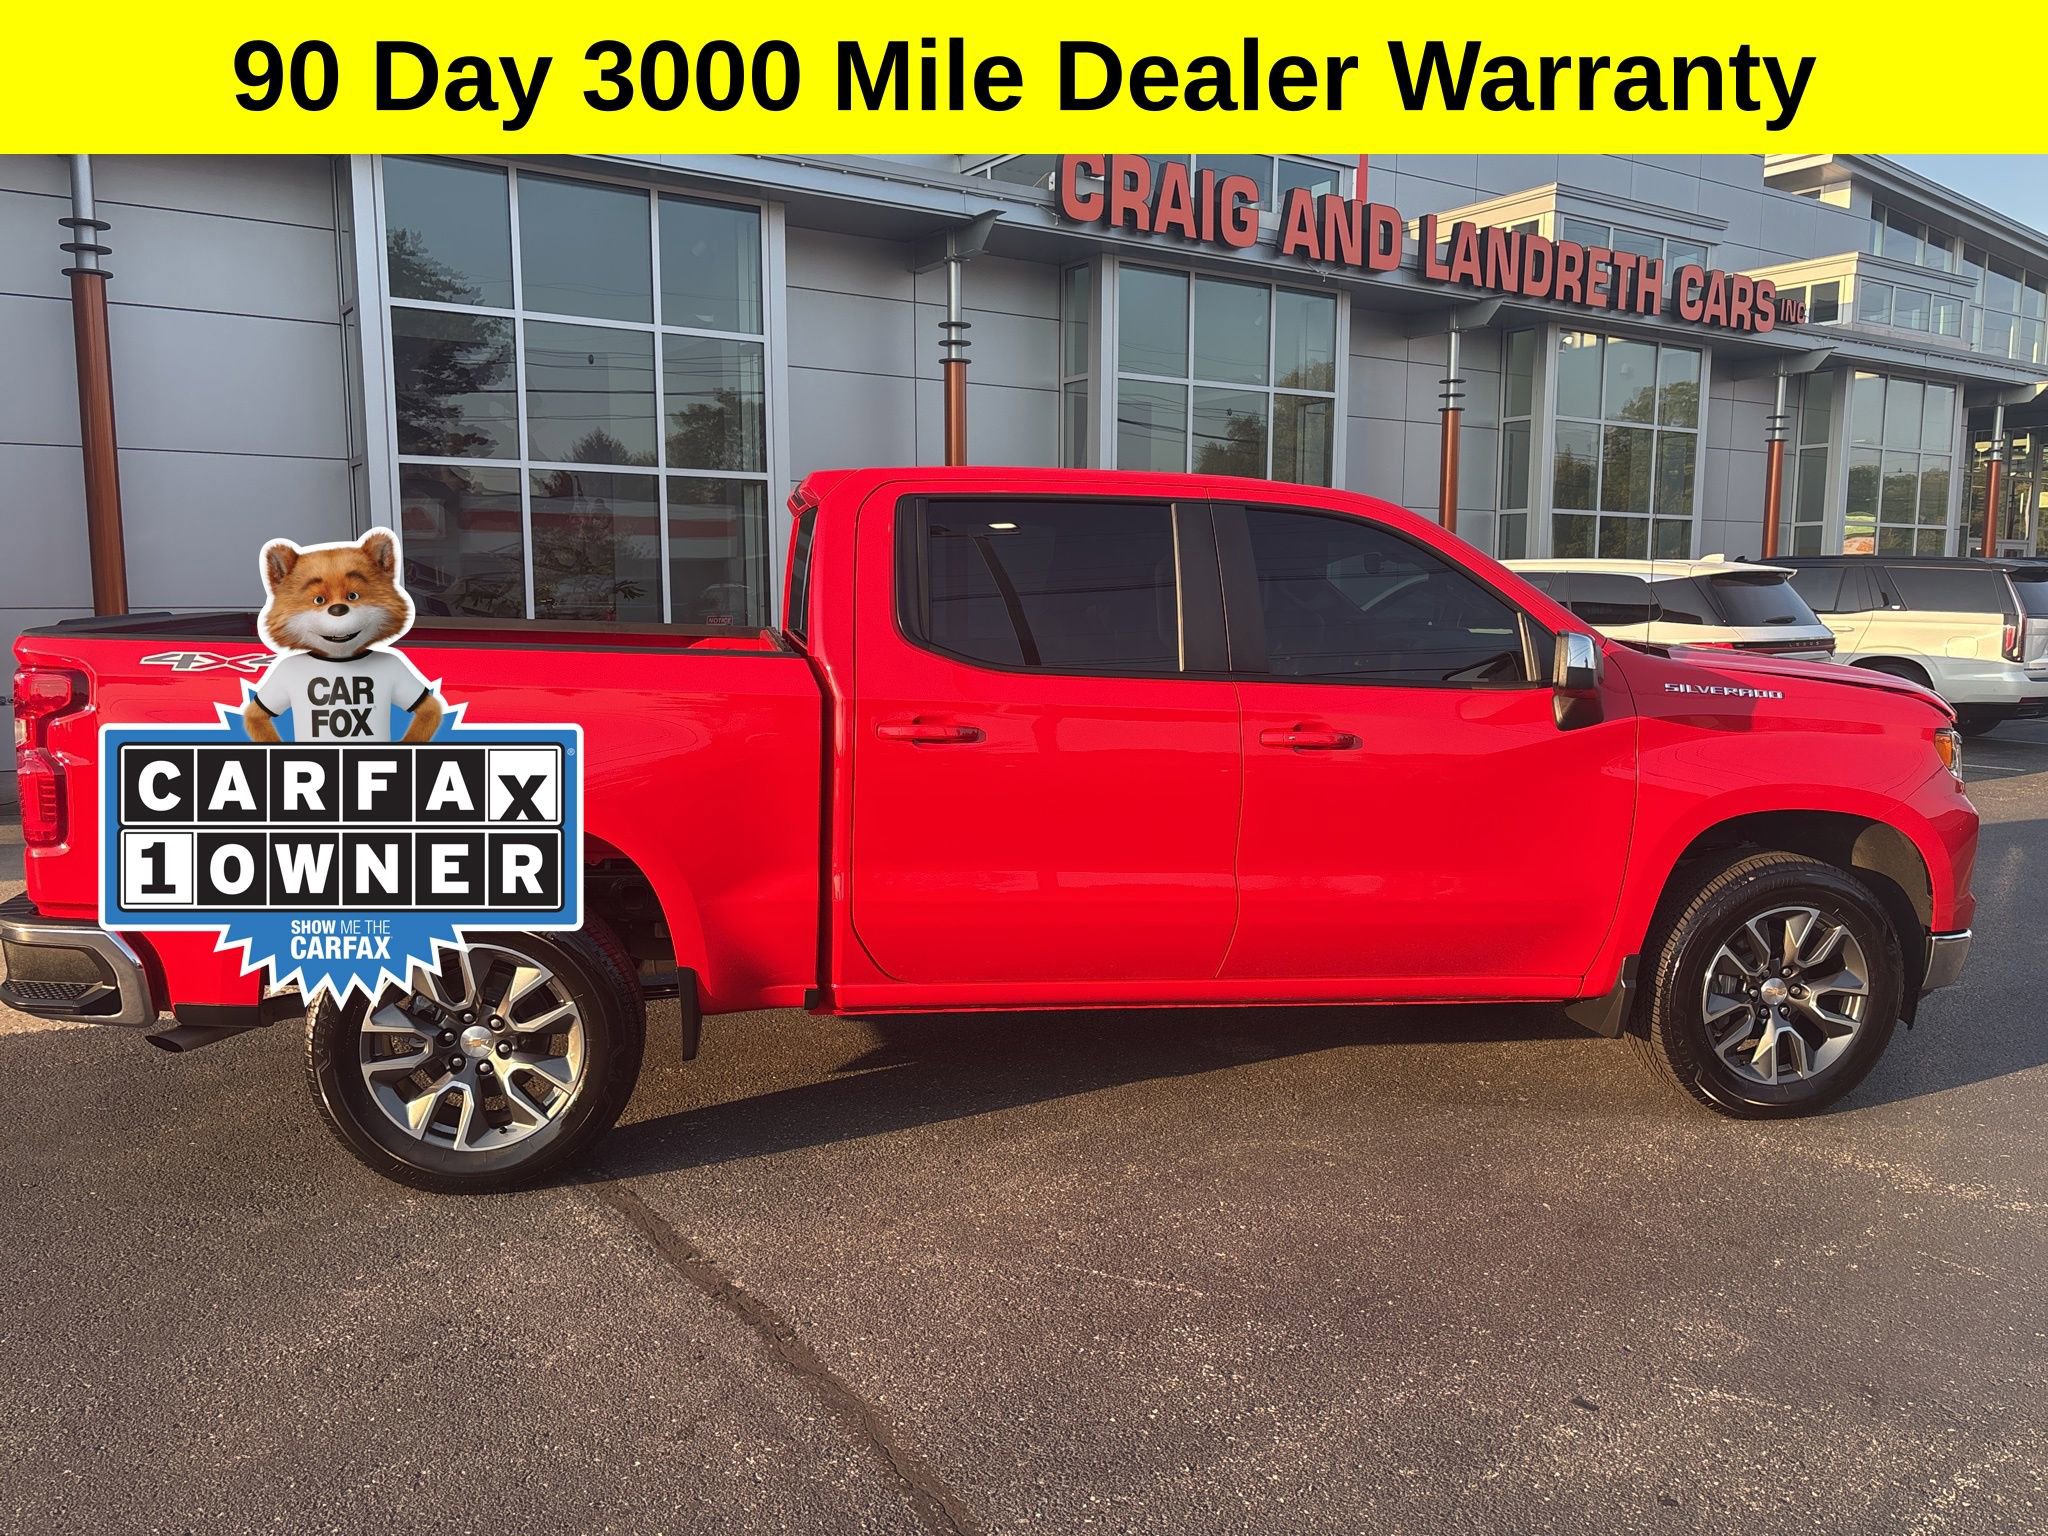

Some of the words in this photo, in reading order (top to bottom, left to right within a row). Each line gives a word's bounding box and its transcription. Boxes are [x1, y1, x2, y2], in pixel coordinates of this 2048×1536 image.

[1058, 154, 1260, 248] CRAIG
[1280, 187, 1403, 271] AND
[1421, 214, 1664, 316] LANDRETH
[1674, 264, 1777, 333] CARS
[1664, 683, 1784, 700] SILVERADO
